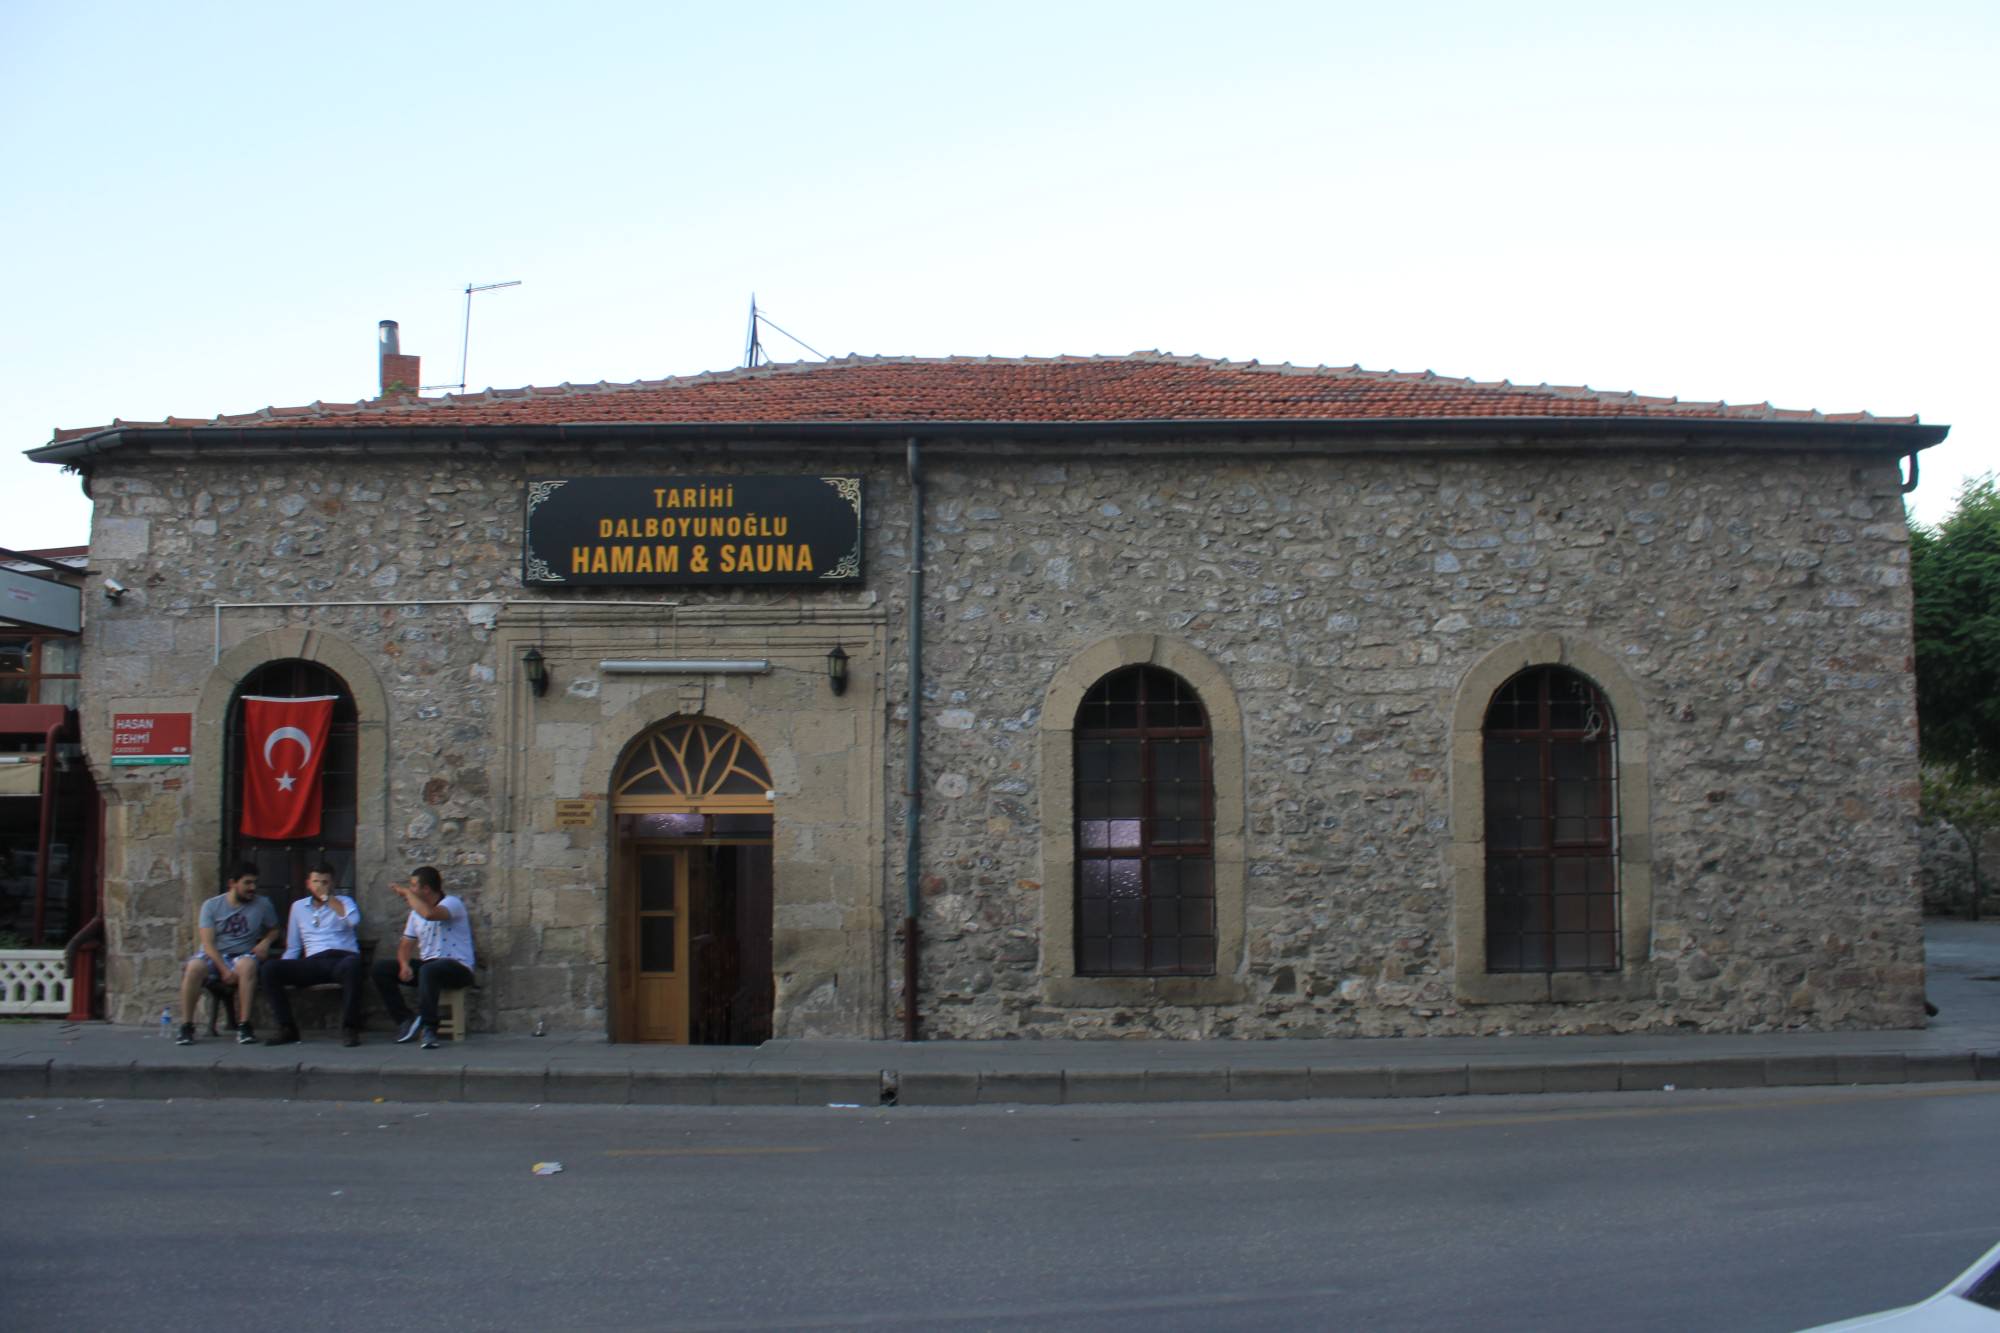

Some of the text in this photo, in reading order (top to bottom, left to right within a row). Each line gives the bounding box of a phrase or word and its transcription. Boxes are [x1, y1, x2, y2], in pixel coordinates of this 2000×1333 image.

[654, 483, 734, 509] TARİHİ
[599, 513, 788, 538] DALBOYUNOĞLU
[571, 543, 814, 574] HAMAM & SAUNA
[115, 718, 154, 729] HASAN
[115, 731, 150, 744] FEHMİ
